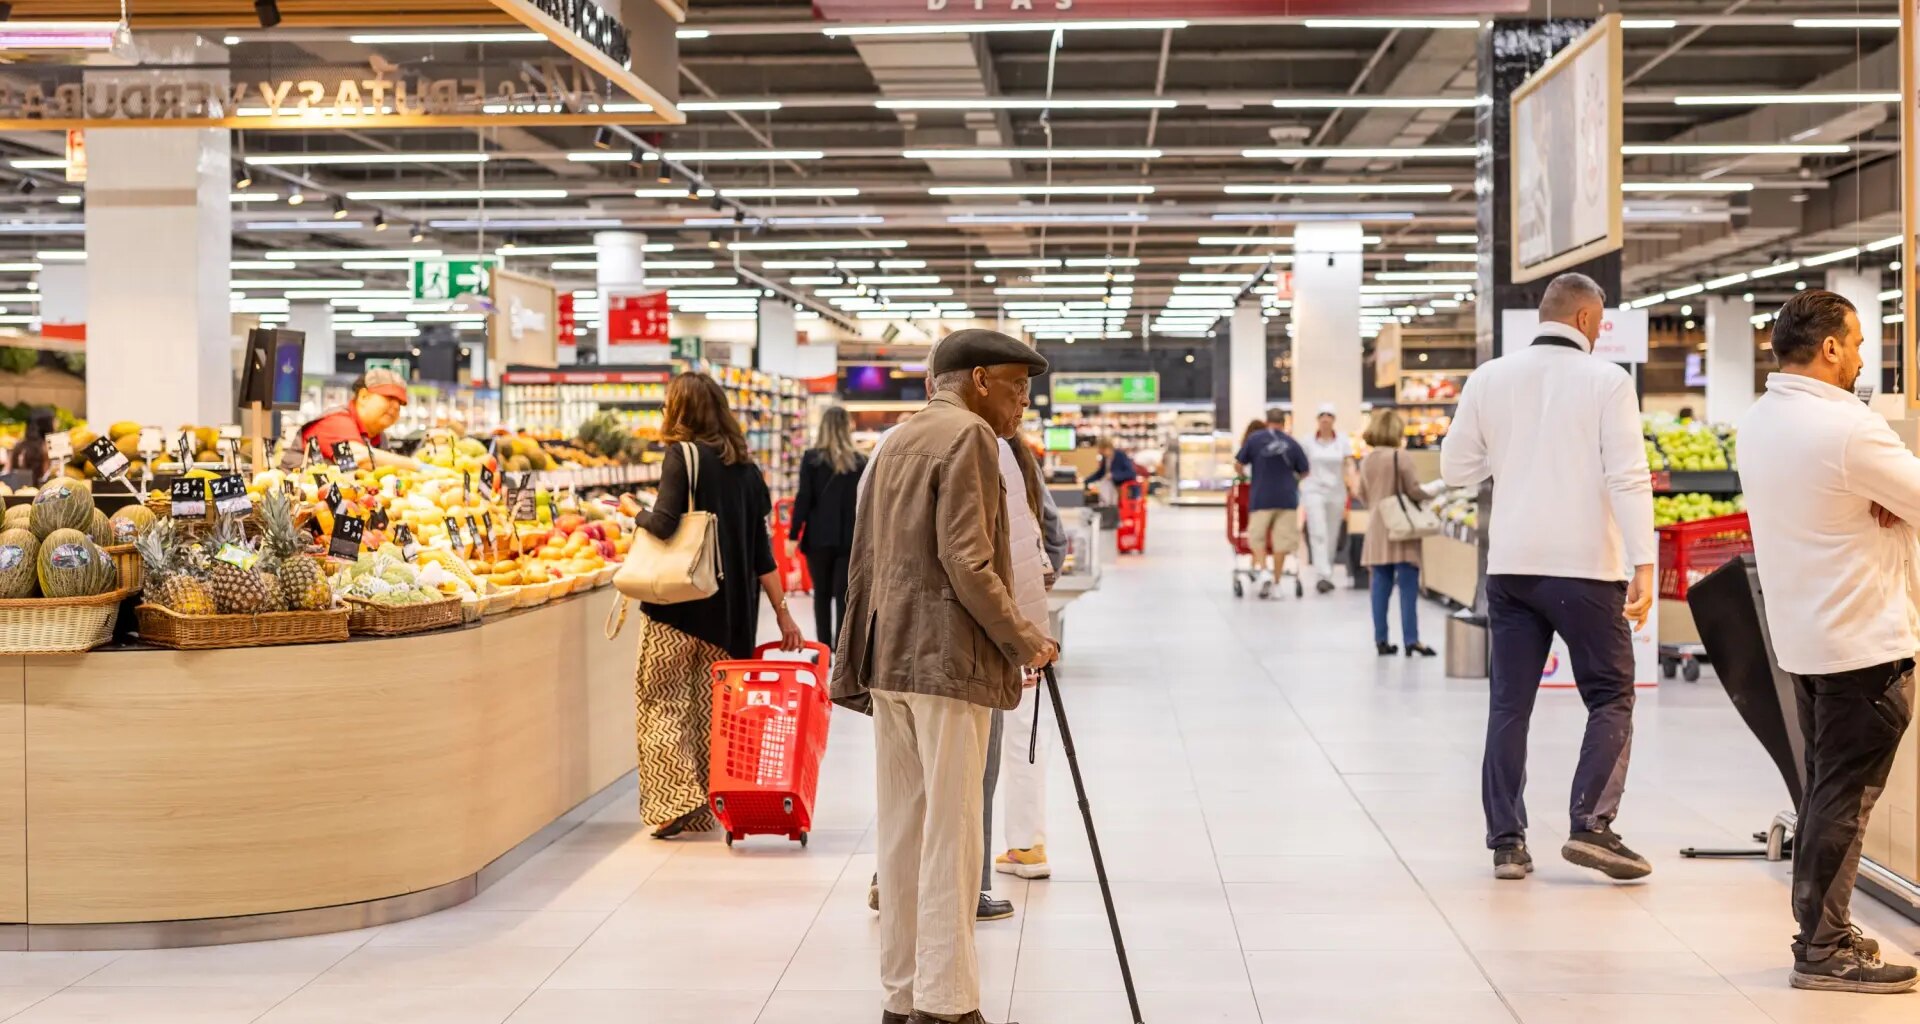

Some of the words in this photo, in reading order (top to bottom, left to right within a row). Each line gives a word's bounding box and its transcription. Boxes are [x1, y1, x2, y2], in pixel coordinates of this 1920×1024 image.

[173, 482, 190, 494] 23
[212, 481, 229, 495] 21
[342, 520, 351, 533] 3
